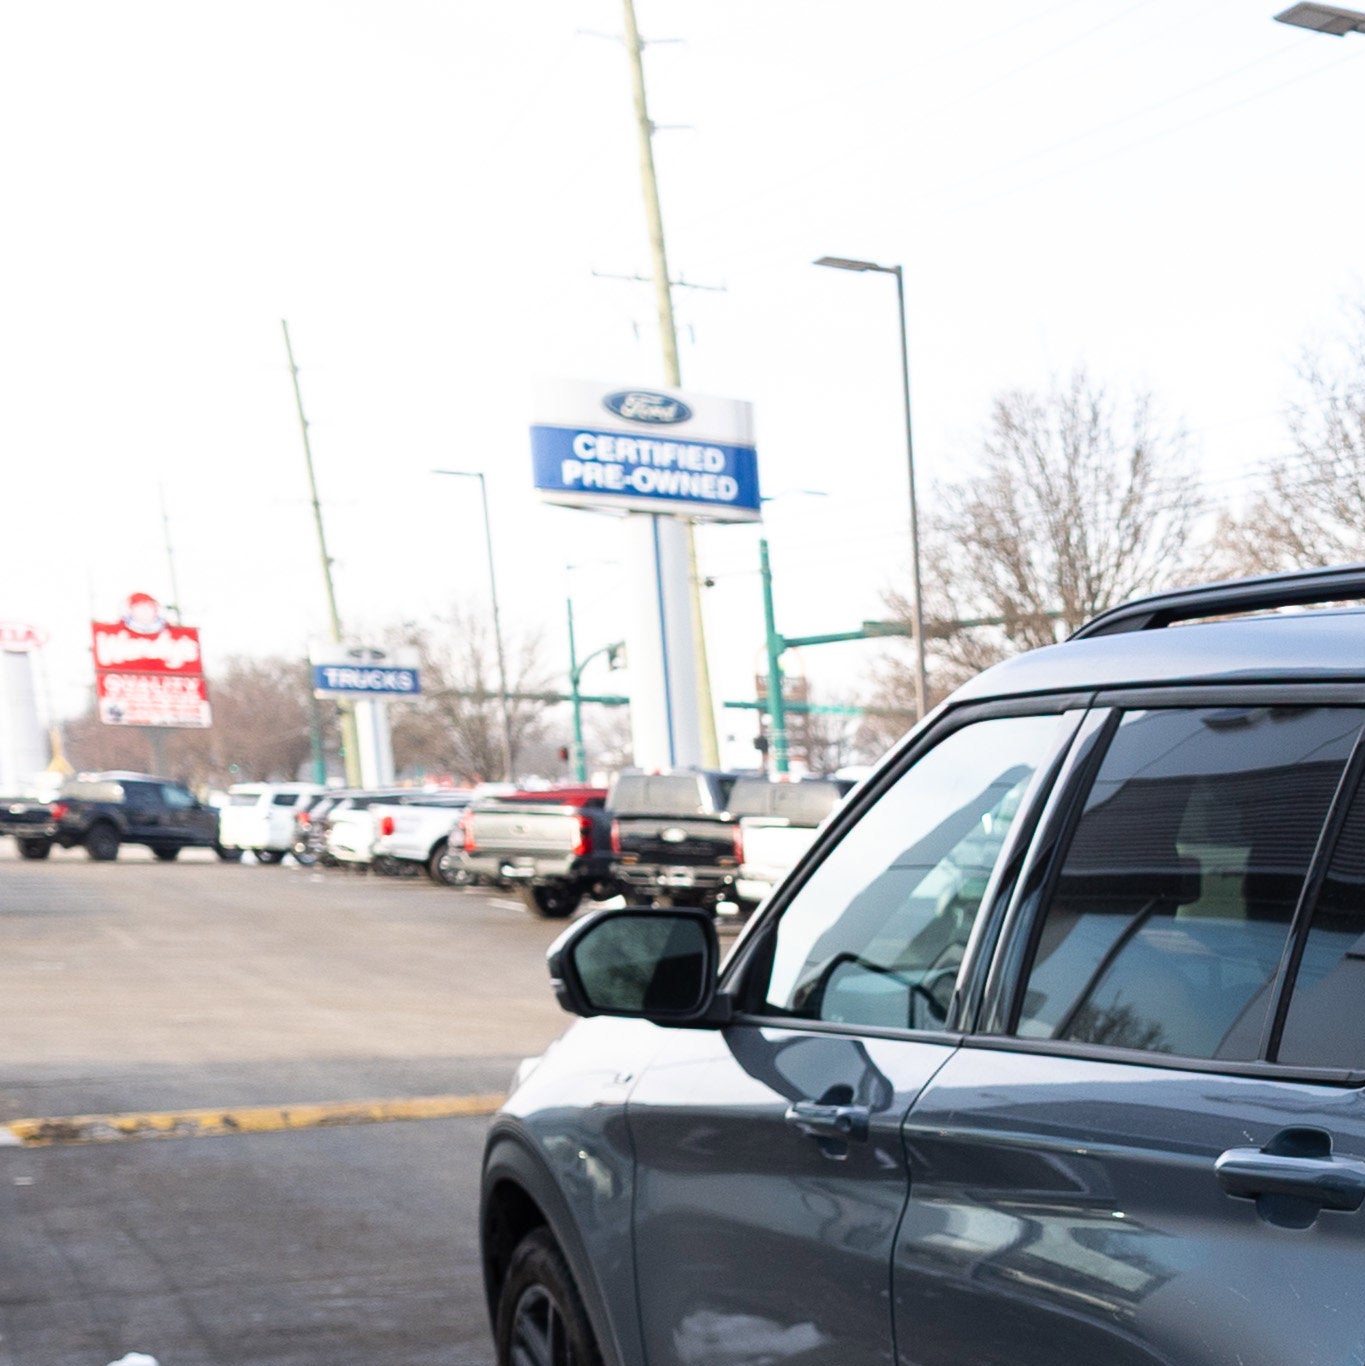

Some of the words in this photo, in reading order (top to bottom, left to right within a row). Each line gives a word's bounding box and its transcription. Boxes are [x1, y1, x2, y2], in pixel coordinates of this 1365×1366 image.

[573, 433, 726, 474] CERTIFIED
[561, 459, 739, 501] PRE-OWNED
[323, 667, 414, 691] TRUCKS
